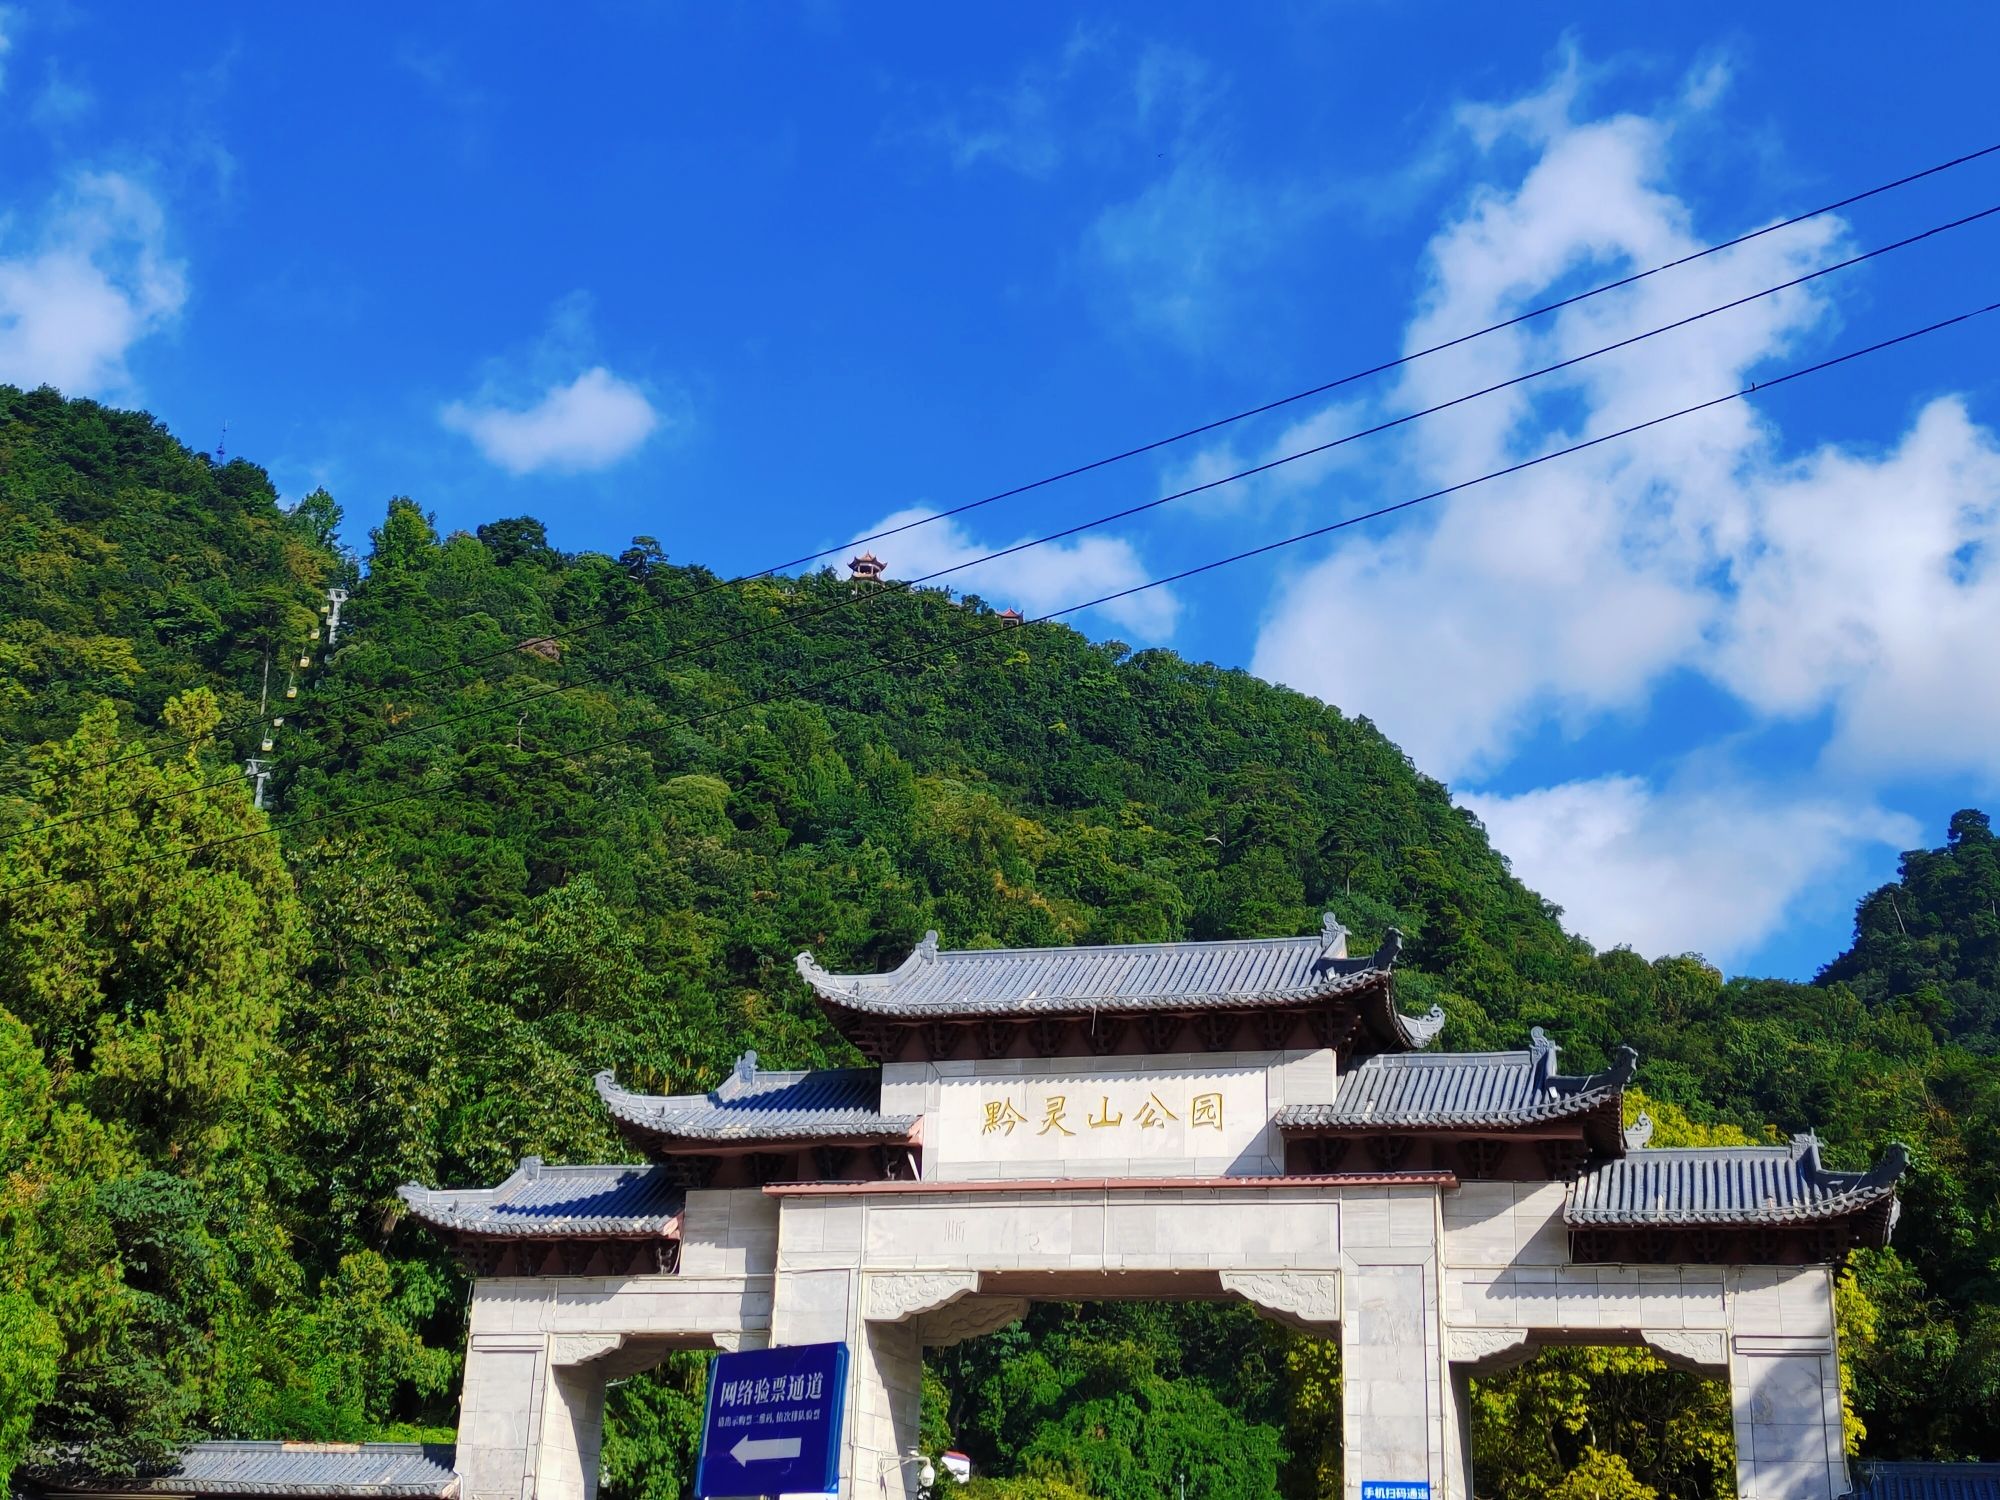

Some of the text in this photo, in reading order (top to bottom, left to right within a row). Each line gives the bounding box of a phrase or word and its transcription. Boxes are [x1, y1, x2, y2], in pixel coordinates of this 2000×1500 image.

[982, 1092, 1224, 1136] 黔灵山公园
[720, 1371, 824, 1407] 网络验票通道
[1364, 1487, 1429, 1500] 手机扫码通道
